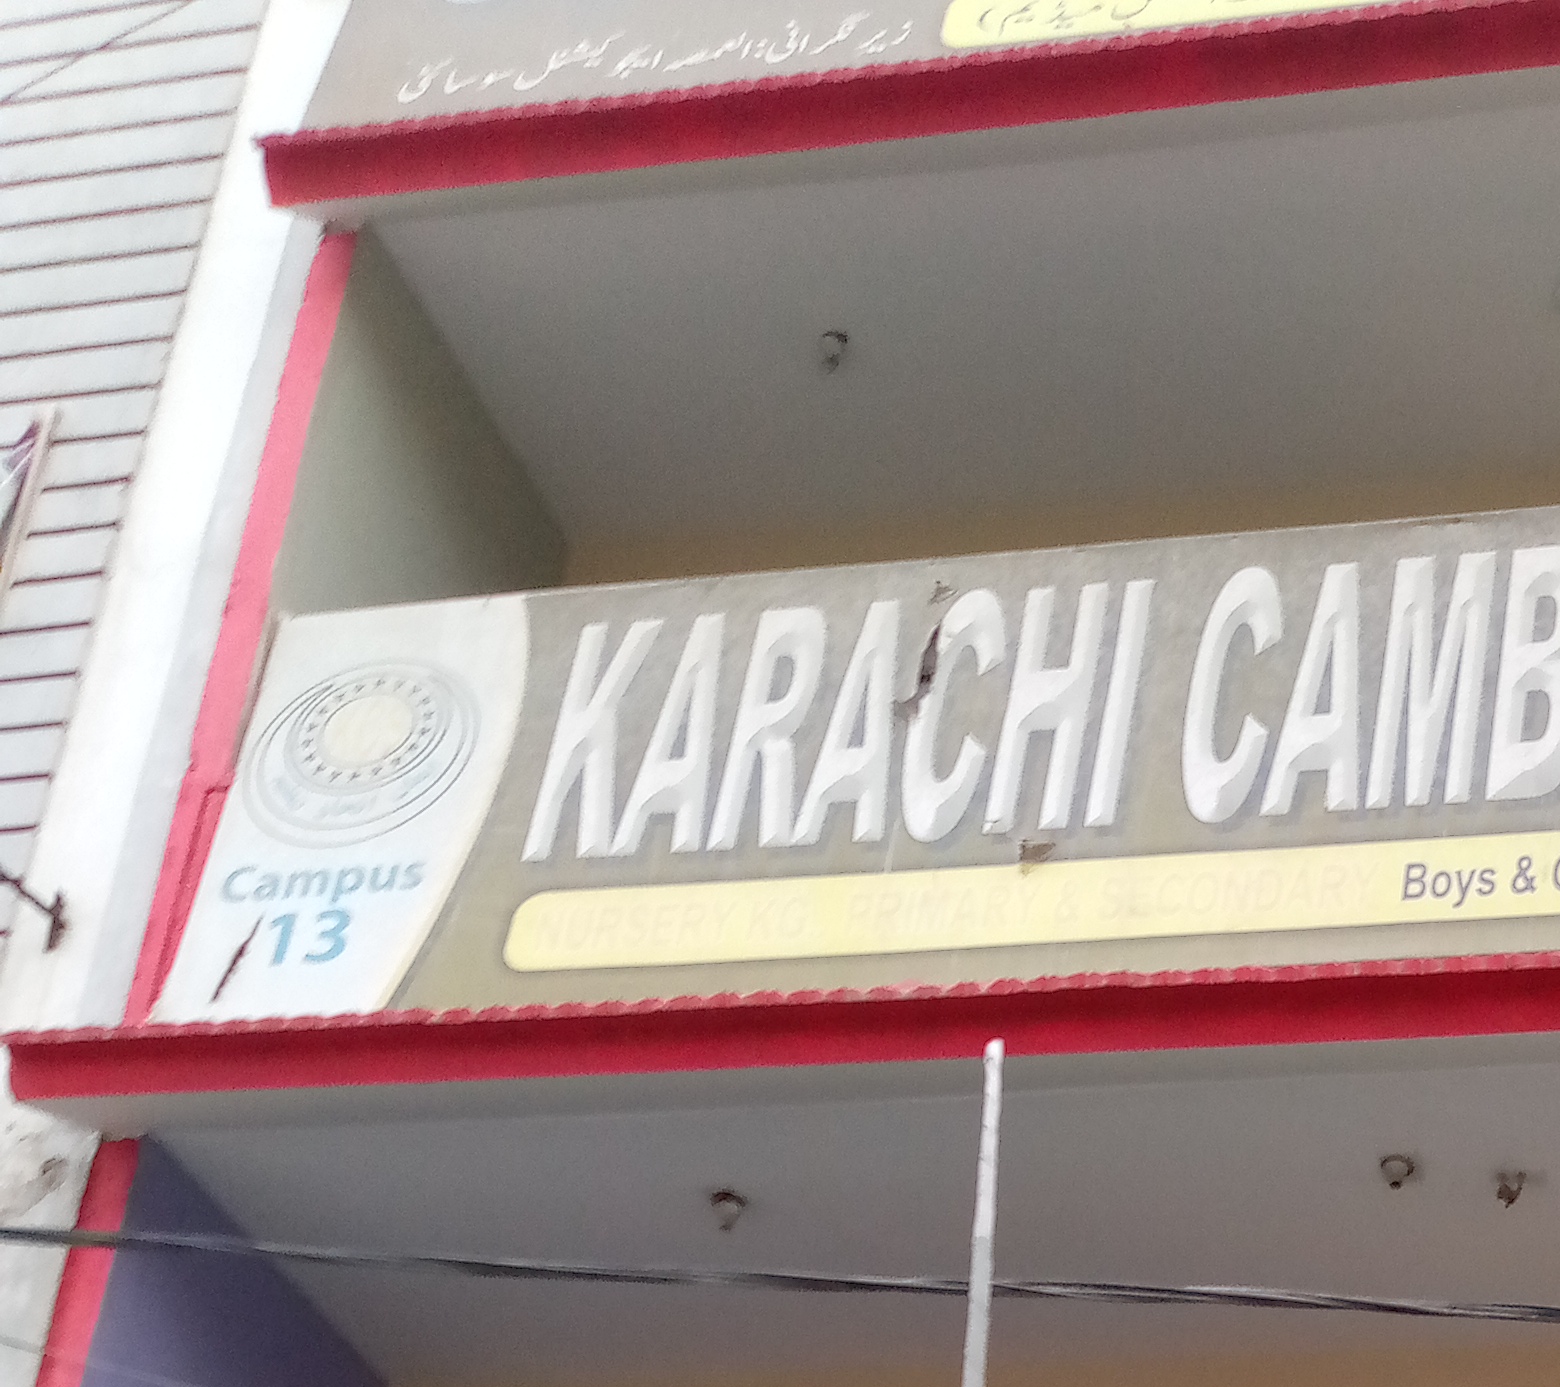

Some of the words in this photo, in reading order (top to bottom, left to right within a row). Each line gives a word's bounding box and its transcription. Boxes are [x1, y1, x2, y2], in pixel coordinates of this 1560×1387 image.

[520, 578, 1156, 864] KARACHI
[220, 860, 428, 903] Campus
[1402, 862, 1496, 908] Boys
[1510, 858, 1539, 895] &
[267, 907, 353, 967] 13
